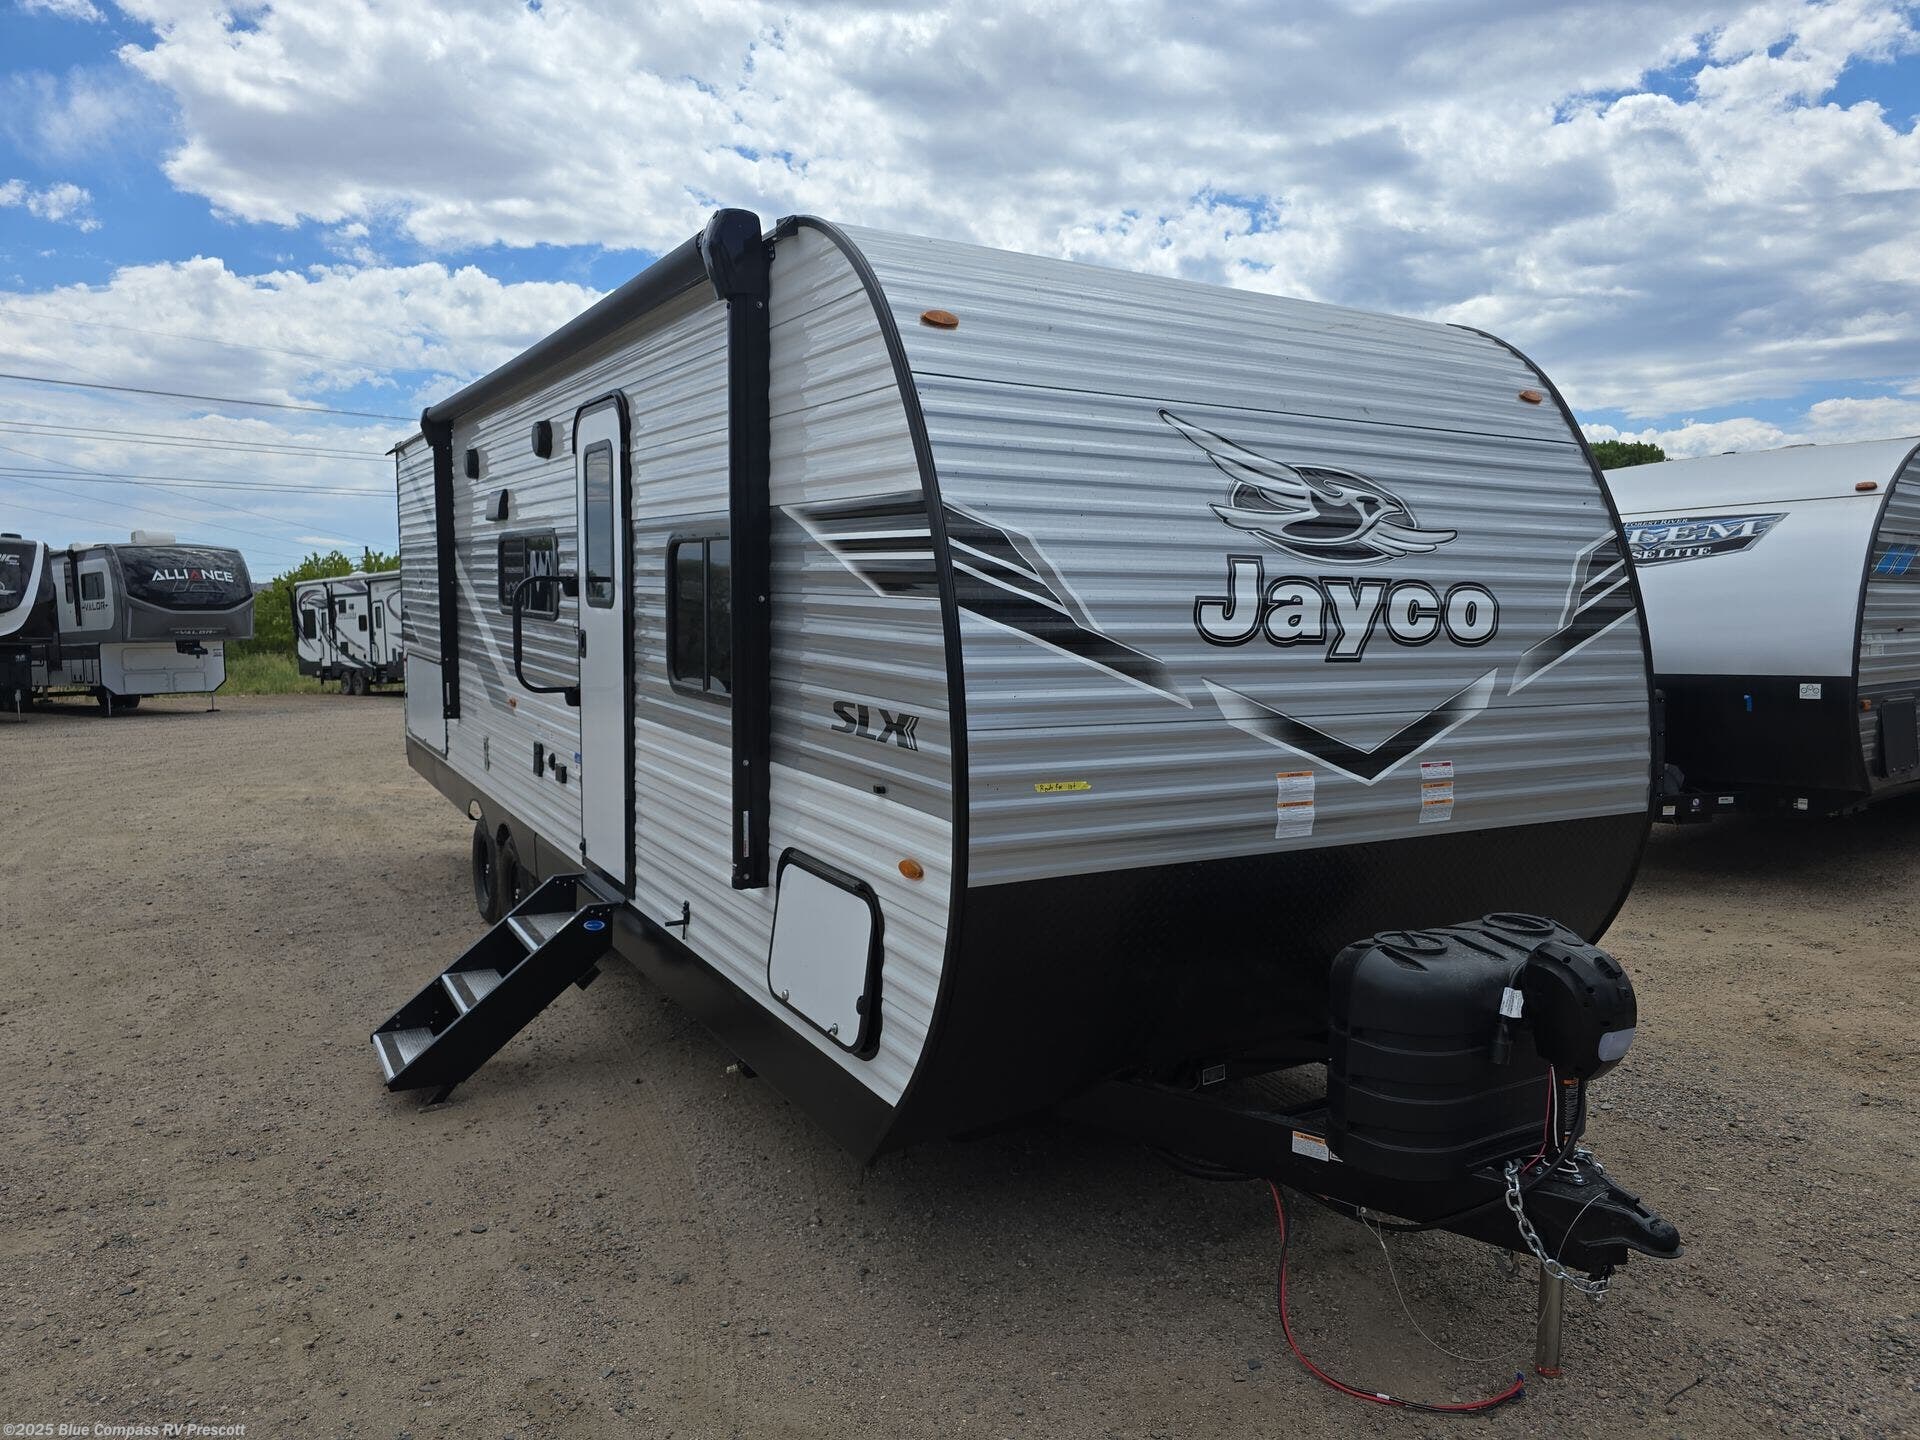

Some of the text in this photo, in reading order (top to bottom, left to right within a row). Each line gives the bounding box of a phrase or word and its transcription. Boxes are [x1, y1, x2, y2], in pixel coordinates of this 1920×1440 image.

[1624, 517, 1688, 528] FOREST RIVER
[1658, 546, 1712, 559] LITE
[151, 568, 234, 583] ALLIANCE
[1193, 554, 1499, 662] Jayco
[830, 700, 920, 752] SLX
